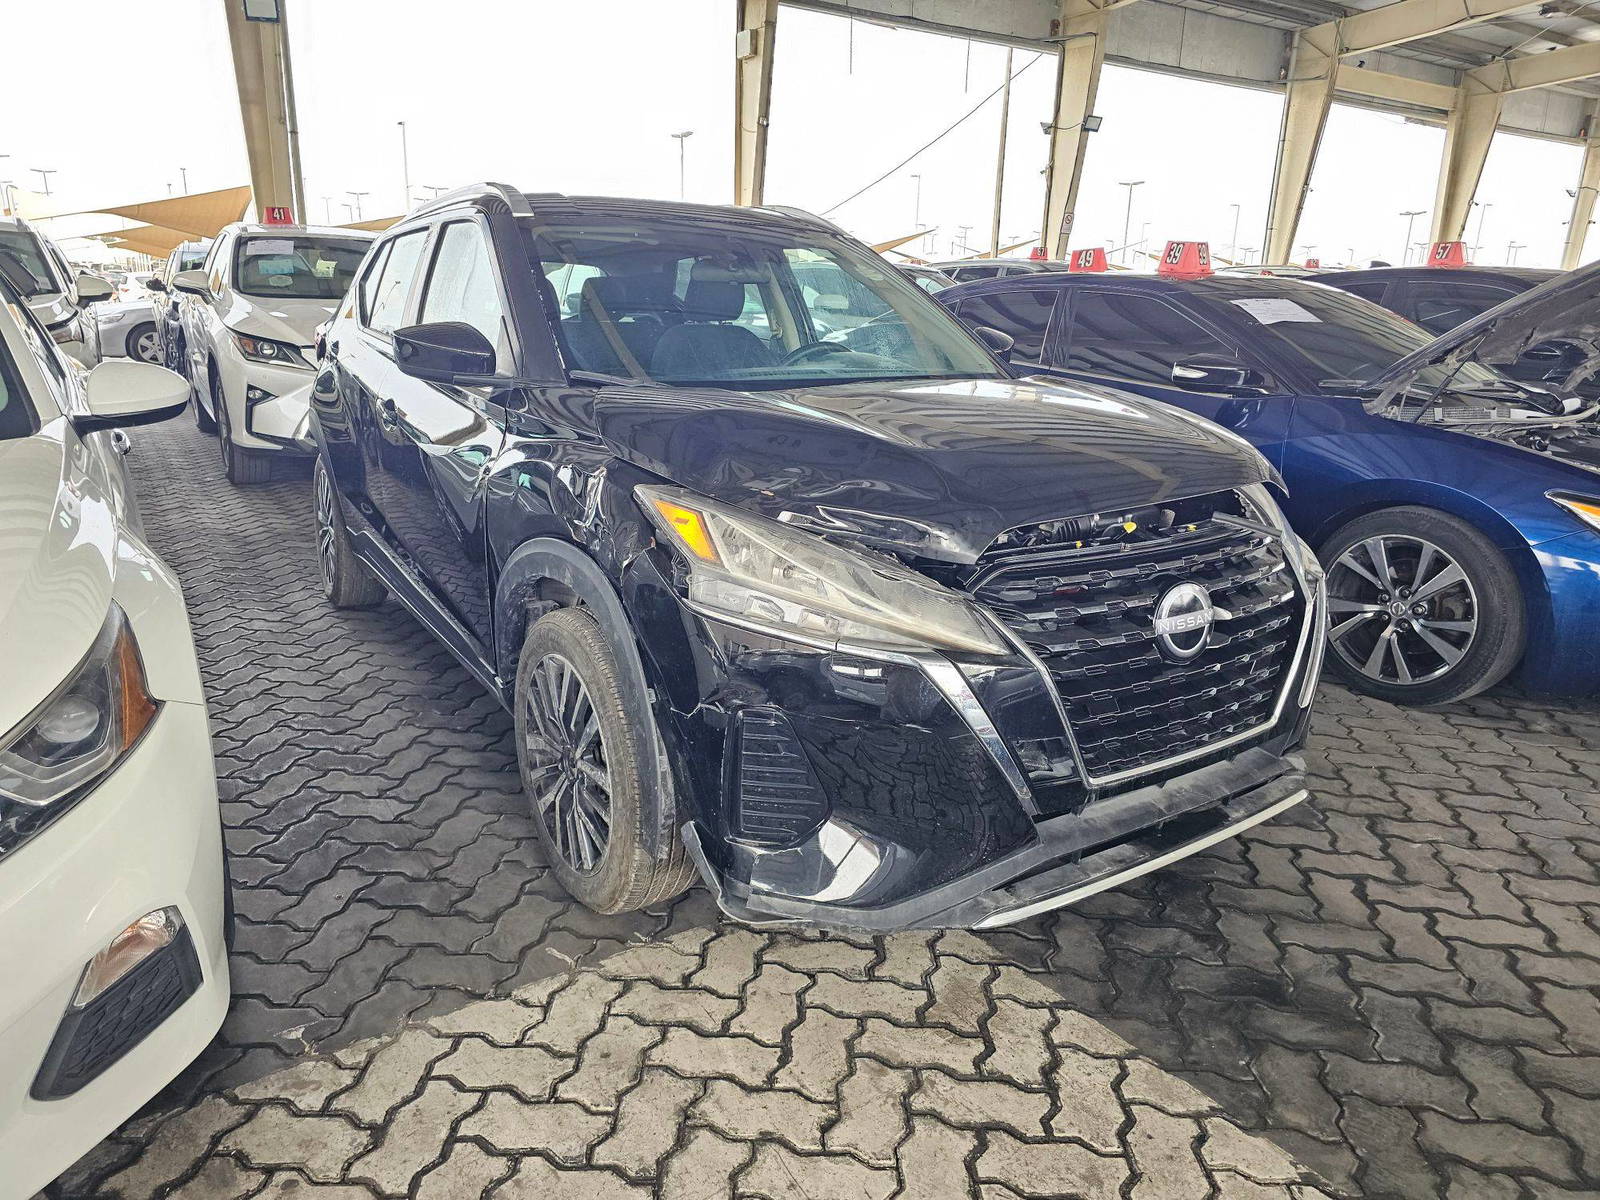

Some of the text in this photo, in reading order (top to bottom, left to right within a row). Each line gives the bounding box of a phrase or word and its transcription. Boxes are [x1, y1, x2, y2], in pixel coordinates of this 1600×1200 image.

[273, 208, 285, 220] 41
[1078, 249, 1094, 268] 49
[1166, 243, 1184, 264] 39
[1435, 243, 1452, 260] 57
[1159, 609, 1213, 632] NISSAN
